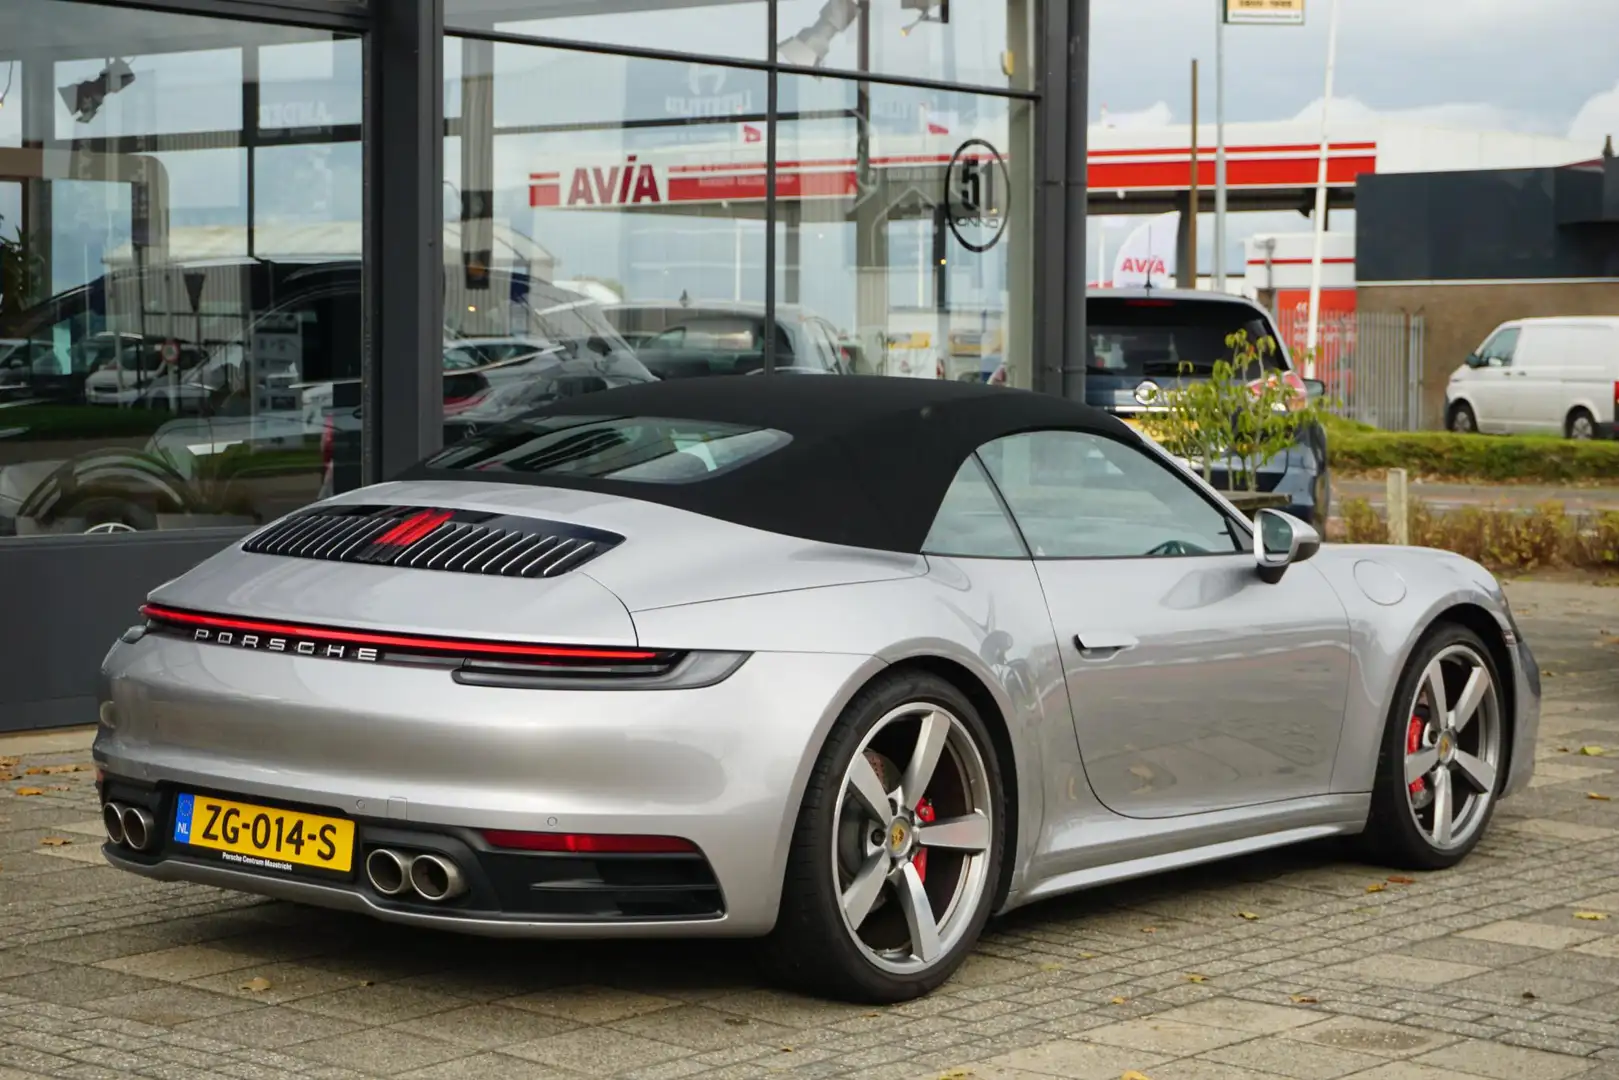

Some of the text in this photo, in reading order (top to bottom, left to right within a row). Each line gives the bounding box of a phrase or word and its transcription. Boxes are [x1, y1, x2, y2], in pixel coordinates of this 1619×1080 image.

[961, 156, 994, 210] 51
[194, 628, 378, 662] PORSCHE
[177, 821, 189, 835] NL
[202, 804, 337, 861] ZG-014-S
[222, 852, 292, 871] Porsche Centrum Maastricht
